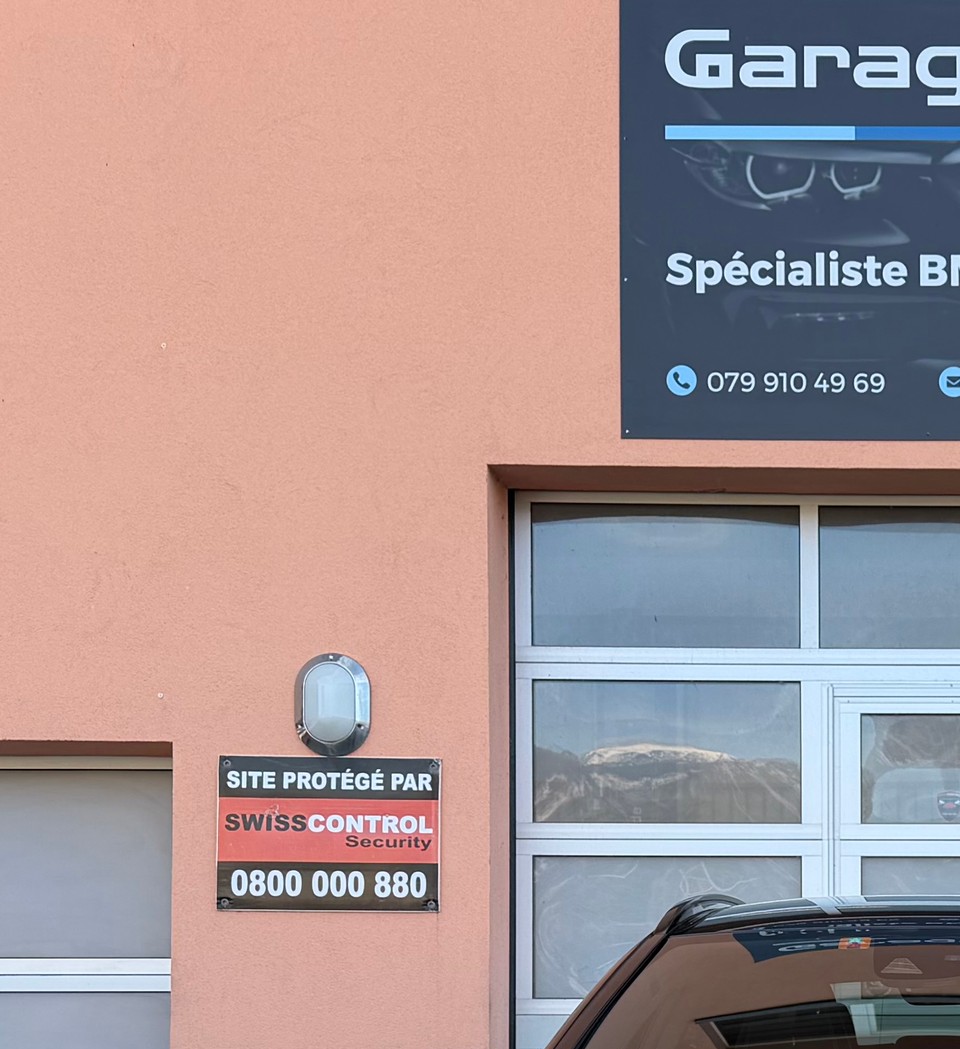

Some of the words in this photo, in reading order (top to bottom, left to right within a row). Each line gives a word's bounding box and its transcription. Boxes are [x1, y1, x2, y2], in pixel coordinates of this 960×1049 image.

[665, 250, 909, 295] Spécialiste
[706, 371, 758, 395] 079
[763, 372, 808, 395] 910
[813, 373, 848, 395] 49
[853, 373, 887, 395] 69
[226, 771, 277, 791] SITE
[283, 769, 386, 792] PROTÉGÉ
[391, 773, 434, 793] PAR
[345, 834, 432, 851] Security
[231, 869, 304, 898] 0800
[312, 870, 367, 899] 000
[374, 871, 428, 899] 880
